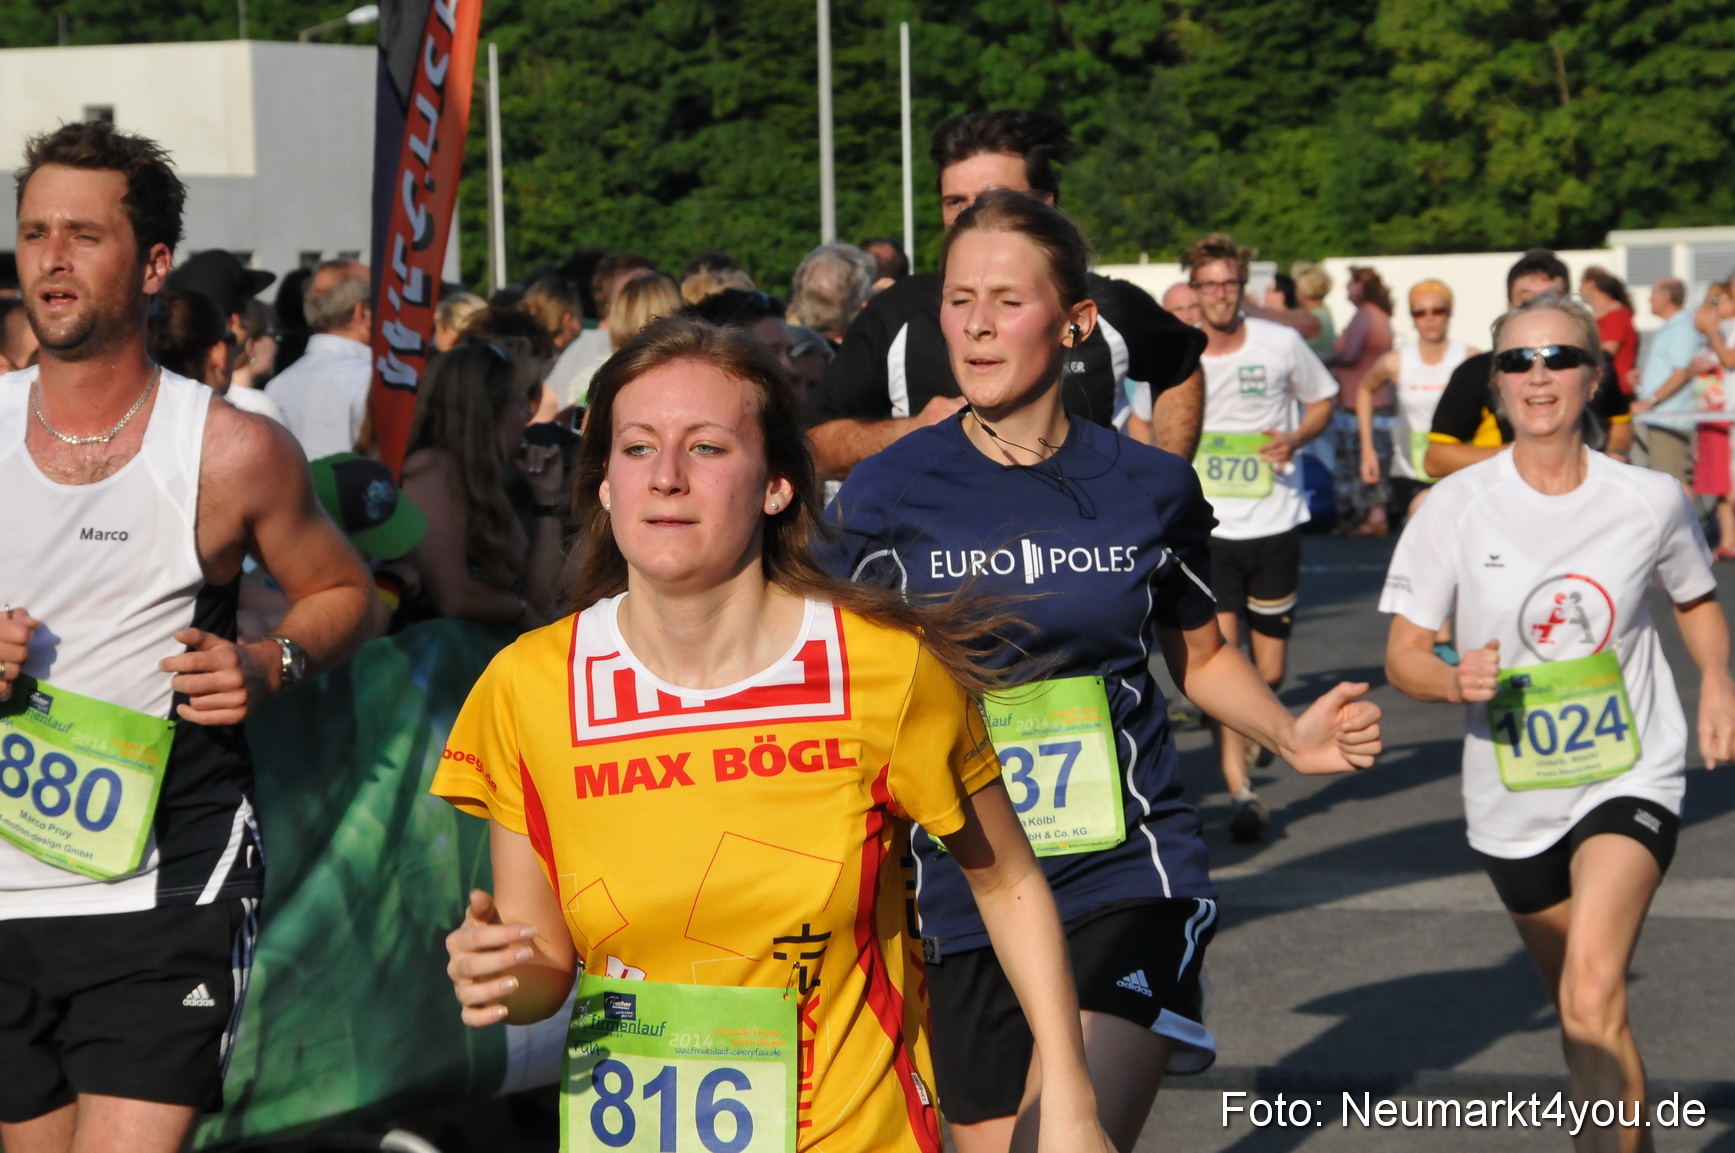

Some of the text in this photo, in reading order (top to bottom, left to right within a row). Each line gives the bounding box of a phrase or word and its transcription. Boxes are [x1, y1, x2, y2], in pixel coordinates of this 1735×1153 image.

[1207, 456, 1260, 481] 870
[79, 527, 129, 541] Marco
[930, 546, 1138, 579] EURO POLES
[1496, 694, 1630, 758] 1024
[573, 735, 858, 800] MAX BÖGL
[0, 732, 123, 833] 880
[19, 810, 73, 840] Marco Pruy
[1028, 815, 1056, 826] Kölbl
[1044, 831, 1052, 839] &
[1054, 829, 1070, 838] Co.
[1072, 827, 1088, 836] KG
[64, 844, 94, 860] GmbH
[1116, 980, 1153, 997] adidas
[182, 998, 216, 1007] adidas
[591, 1013, 667, 1037] firmenlauf
[669, 1032, 714, 1048] 2014
[589, 1058, 754, 1153] 816
